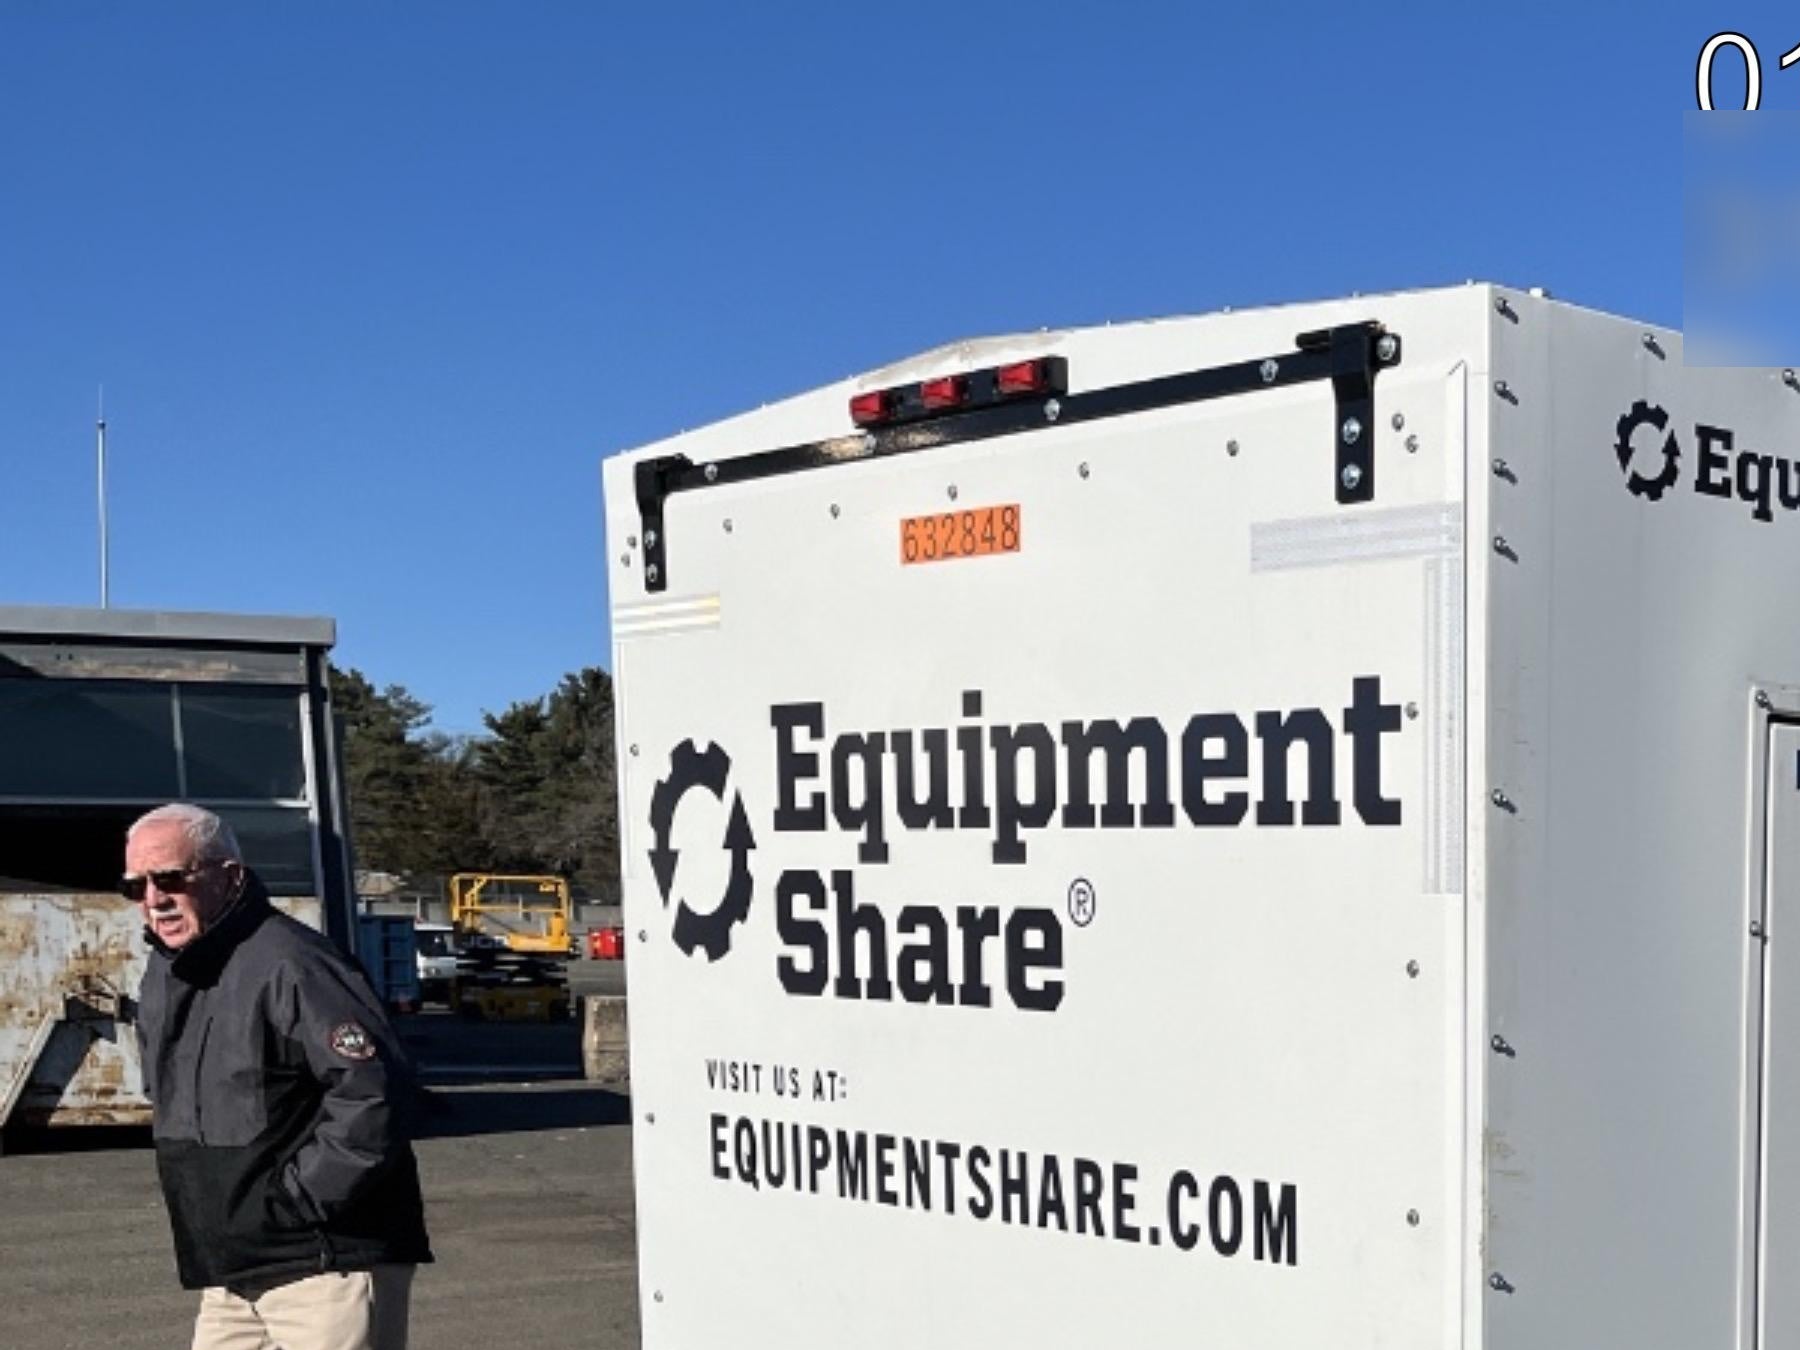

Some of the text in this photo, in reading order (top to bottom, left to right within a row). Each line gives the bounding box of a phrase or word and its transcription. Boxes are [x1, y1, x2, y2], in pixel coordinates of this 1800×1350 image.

[903, 506, 1018, 562] 632848
[770, 676, 1402, 864] Equipment
[705, 1058, 847, 1102] VISIT US AT:
[710, 1113, 1298, 1267] EQUIPMENTSHARE.COM
